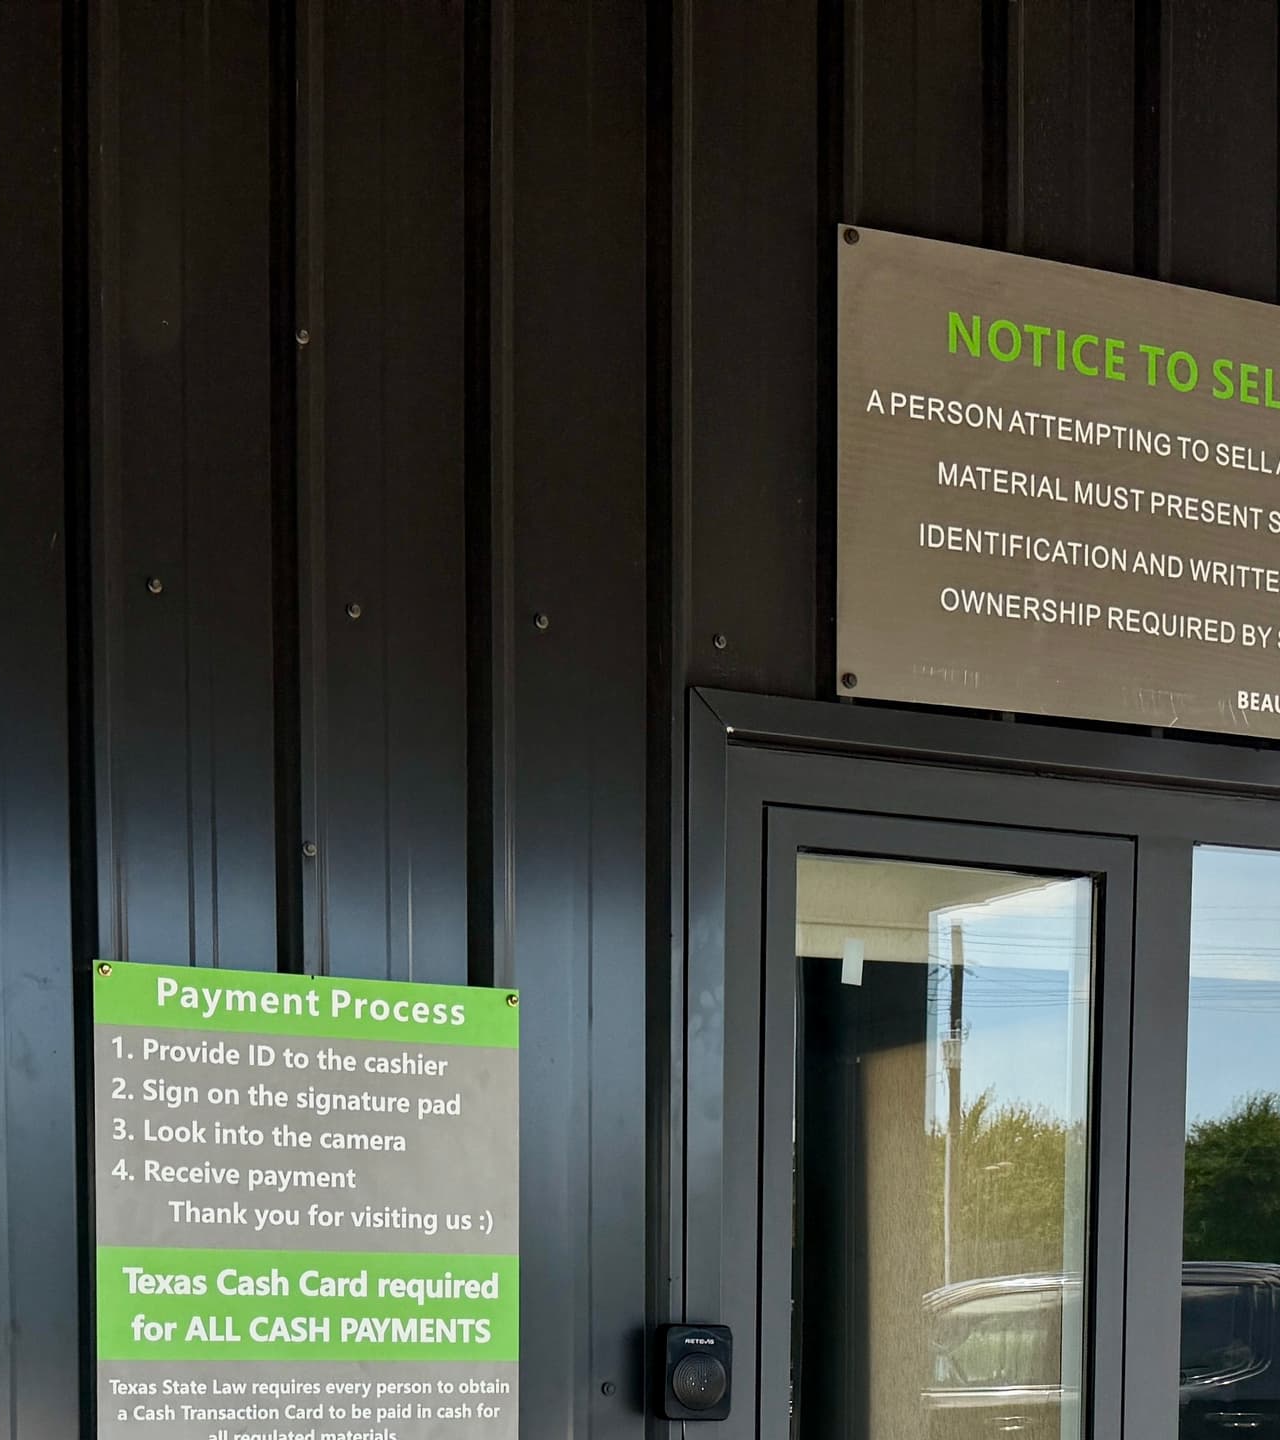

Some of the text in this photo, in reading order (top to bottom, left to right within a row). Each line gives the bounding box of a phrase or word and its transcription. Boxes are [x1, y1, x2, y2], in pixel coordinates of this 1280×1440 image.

[949, 312, 1125, 381] NOTICE
[1140, 345, 1198, 392] TO
[866, 389, 885, 414] A
[891, 391, 1003, 431] PERSON
[1008, 410, 1171, 456] ATTEMPTING
[1177, 436, 1209, 462] TO
[1215, 443, 1273, 474] SELL
[938, 461, 1068, 502] MATERIAL
[1075, 480, 1145, 512] MUST
[1151, 492, 1263, 530] PRESENT
[920, 523, 1127, 572] IDENTIFICATION
[1132, 551, 1183, 578] AND
[941, 587, 1101, 627] OWNERSHIP
[1108, 606, 1236, 643] REQUIRED
[1242, 623, 1272, 648] BY
[157, 976, 465, 1026] Payment Process
[112, 1036, 448, 1076] 1. Provide ID to the cashier
[111, 1077, 461, 1119] 2. Sign on the signature pad
[112, 1118, 406, 1152] 3. Look into the camera
[111, 1158, 356, 1192] 4. Receive payment
[168, 1200, 248, 1224] Thank
[254, 1208, 300, 1231] you
[307, 1204, 345, 1227] for
[350, 1205, 438, 1236] visiting
[446, 1214, 472, 1230] us
[122, 1266, 499, 1306] Texas Cash Card required
[131, 1314, 491, 1343] for ALL CASH PAYMENTS
[109, 1378, 510, 1399] Texas State Law requires every person to obtain
